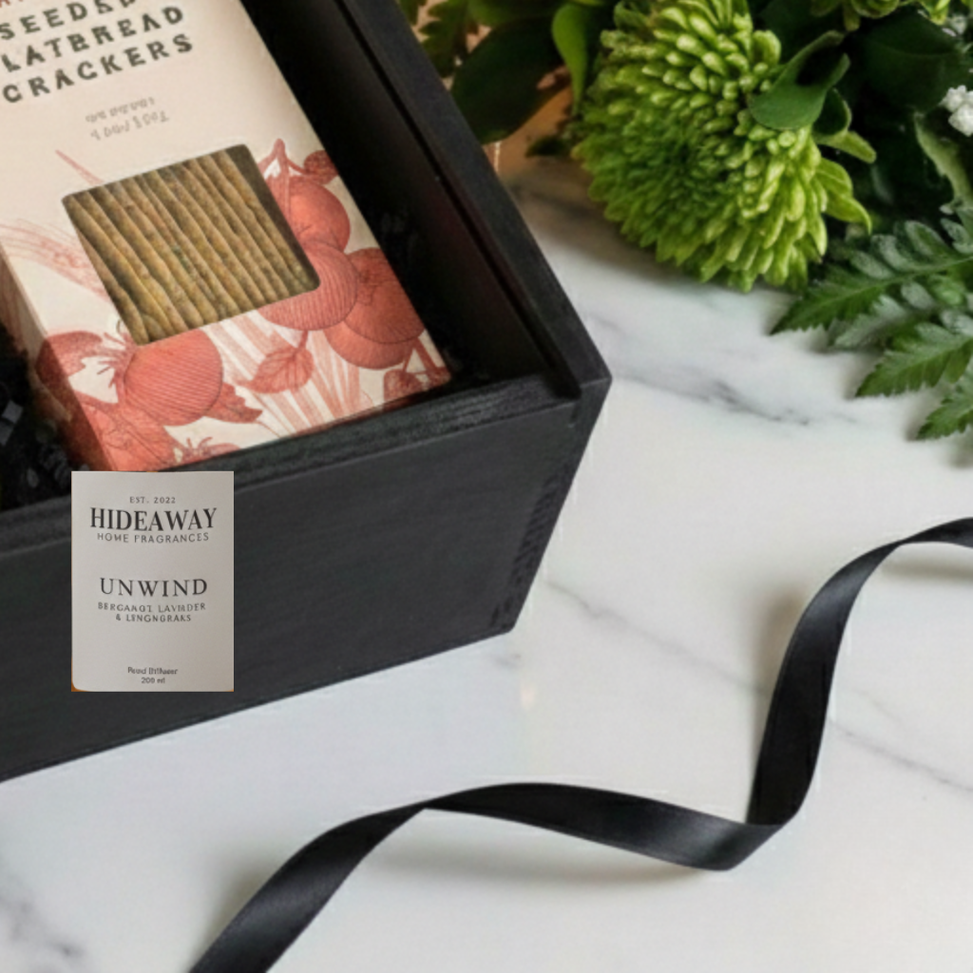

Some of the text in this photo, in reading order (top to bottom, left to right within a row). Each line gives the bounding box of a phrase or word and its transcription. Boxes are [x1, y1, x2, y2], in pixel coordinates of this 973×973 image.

[2, 33, 193, 104] CRACKERS
[129, 496, 176, 504] EST. 2022
[90, 507, 217, 532] HIDEAWAY
[97, 532, 209, 544] HOME FRAGRANCES
[100, 577, 207, 597] UNWIND
